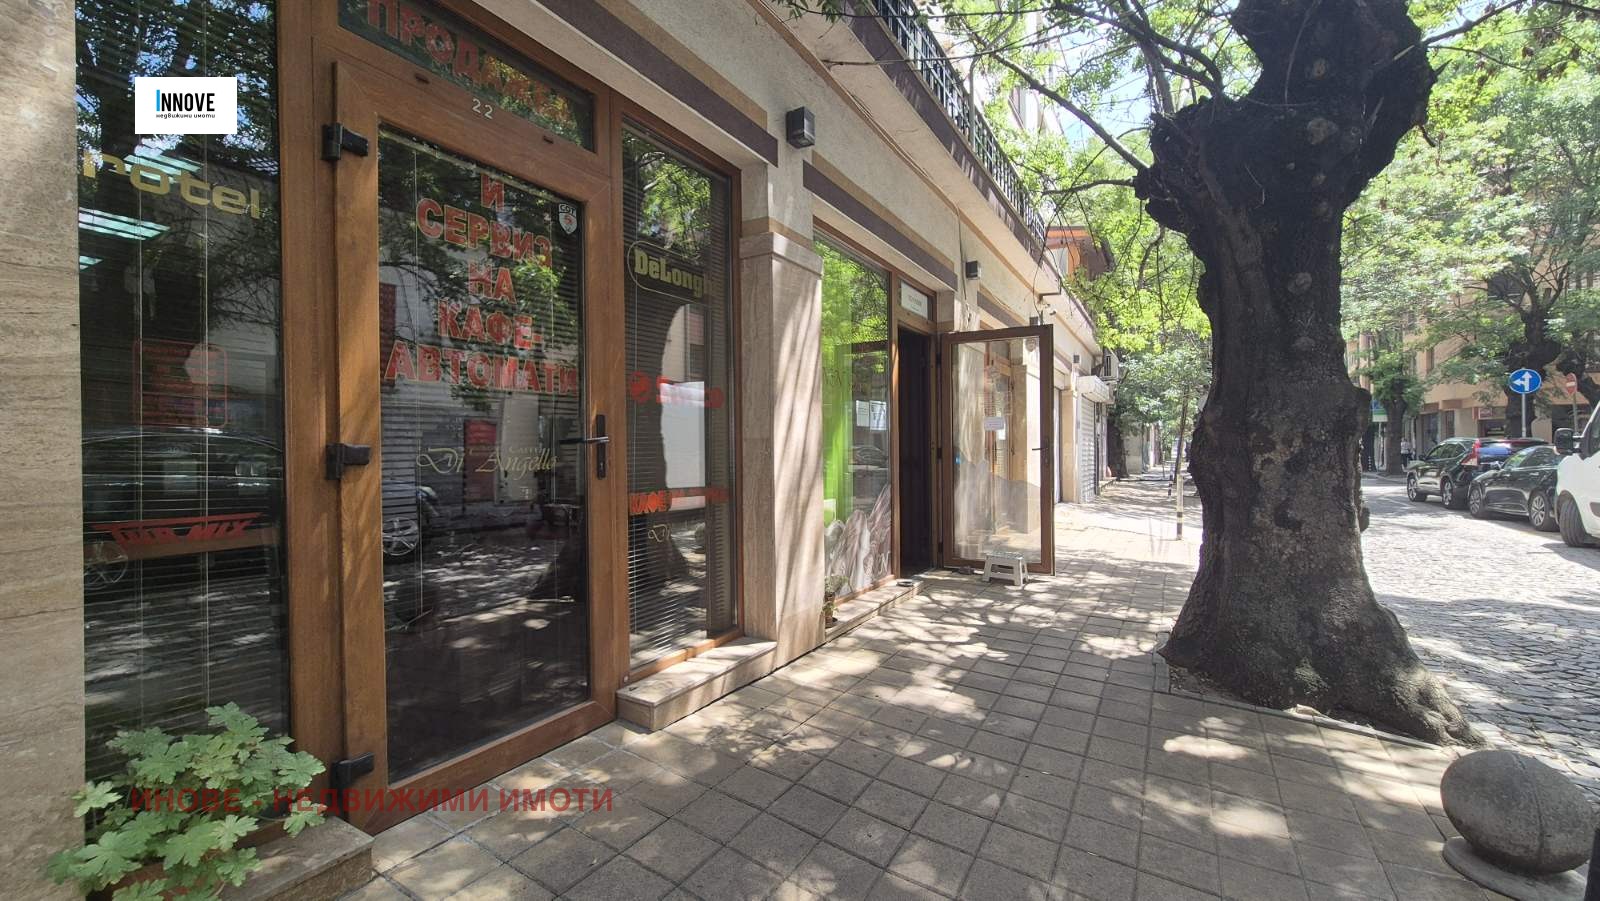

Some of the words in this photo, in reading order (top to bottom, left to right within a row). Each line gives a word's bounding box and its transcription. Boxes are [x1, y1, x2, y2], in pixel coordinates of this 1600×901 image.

[472, 98, 493, 119] 22
[481, 173, 504, 213] И
[416, 198, 552, 270] СЕРВИЗ
[468, 261, 517, 305] НА
[383, 340, 577, 397] АВТОМАТИ
